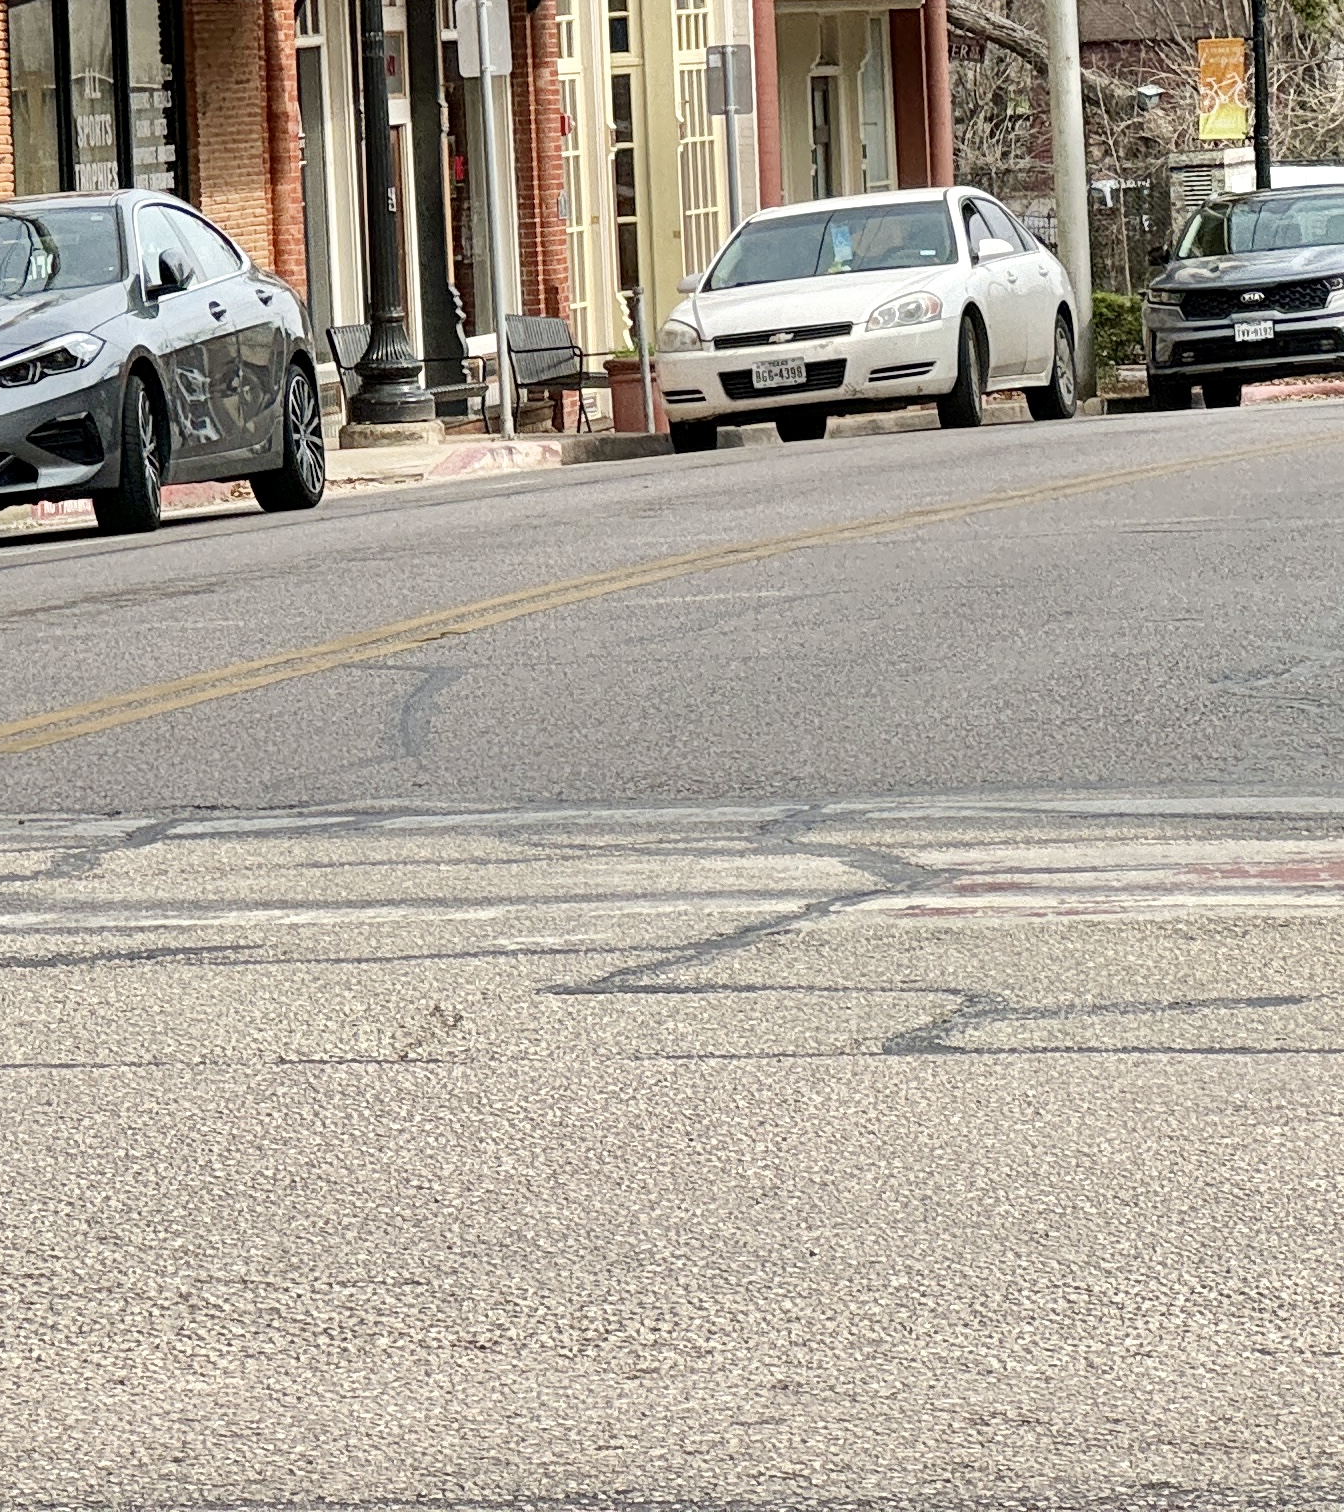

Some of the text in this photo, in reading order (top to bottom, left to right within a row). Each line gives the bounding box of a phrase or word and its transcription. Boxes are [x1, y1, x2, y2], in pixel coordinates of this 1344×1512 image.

[84, 67, 101, 99] ALL
[76, 113, 113, 148] SPORTS
[74, 161, 120, 191] TROPHIES
